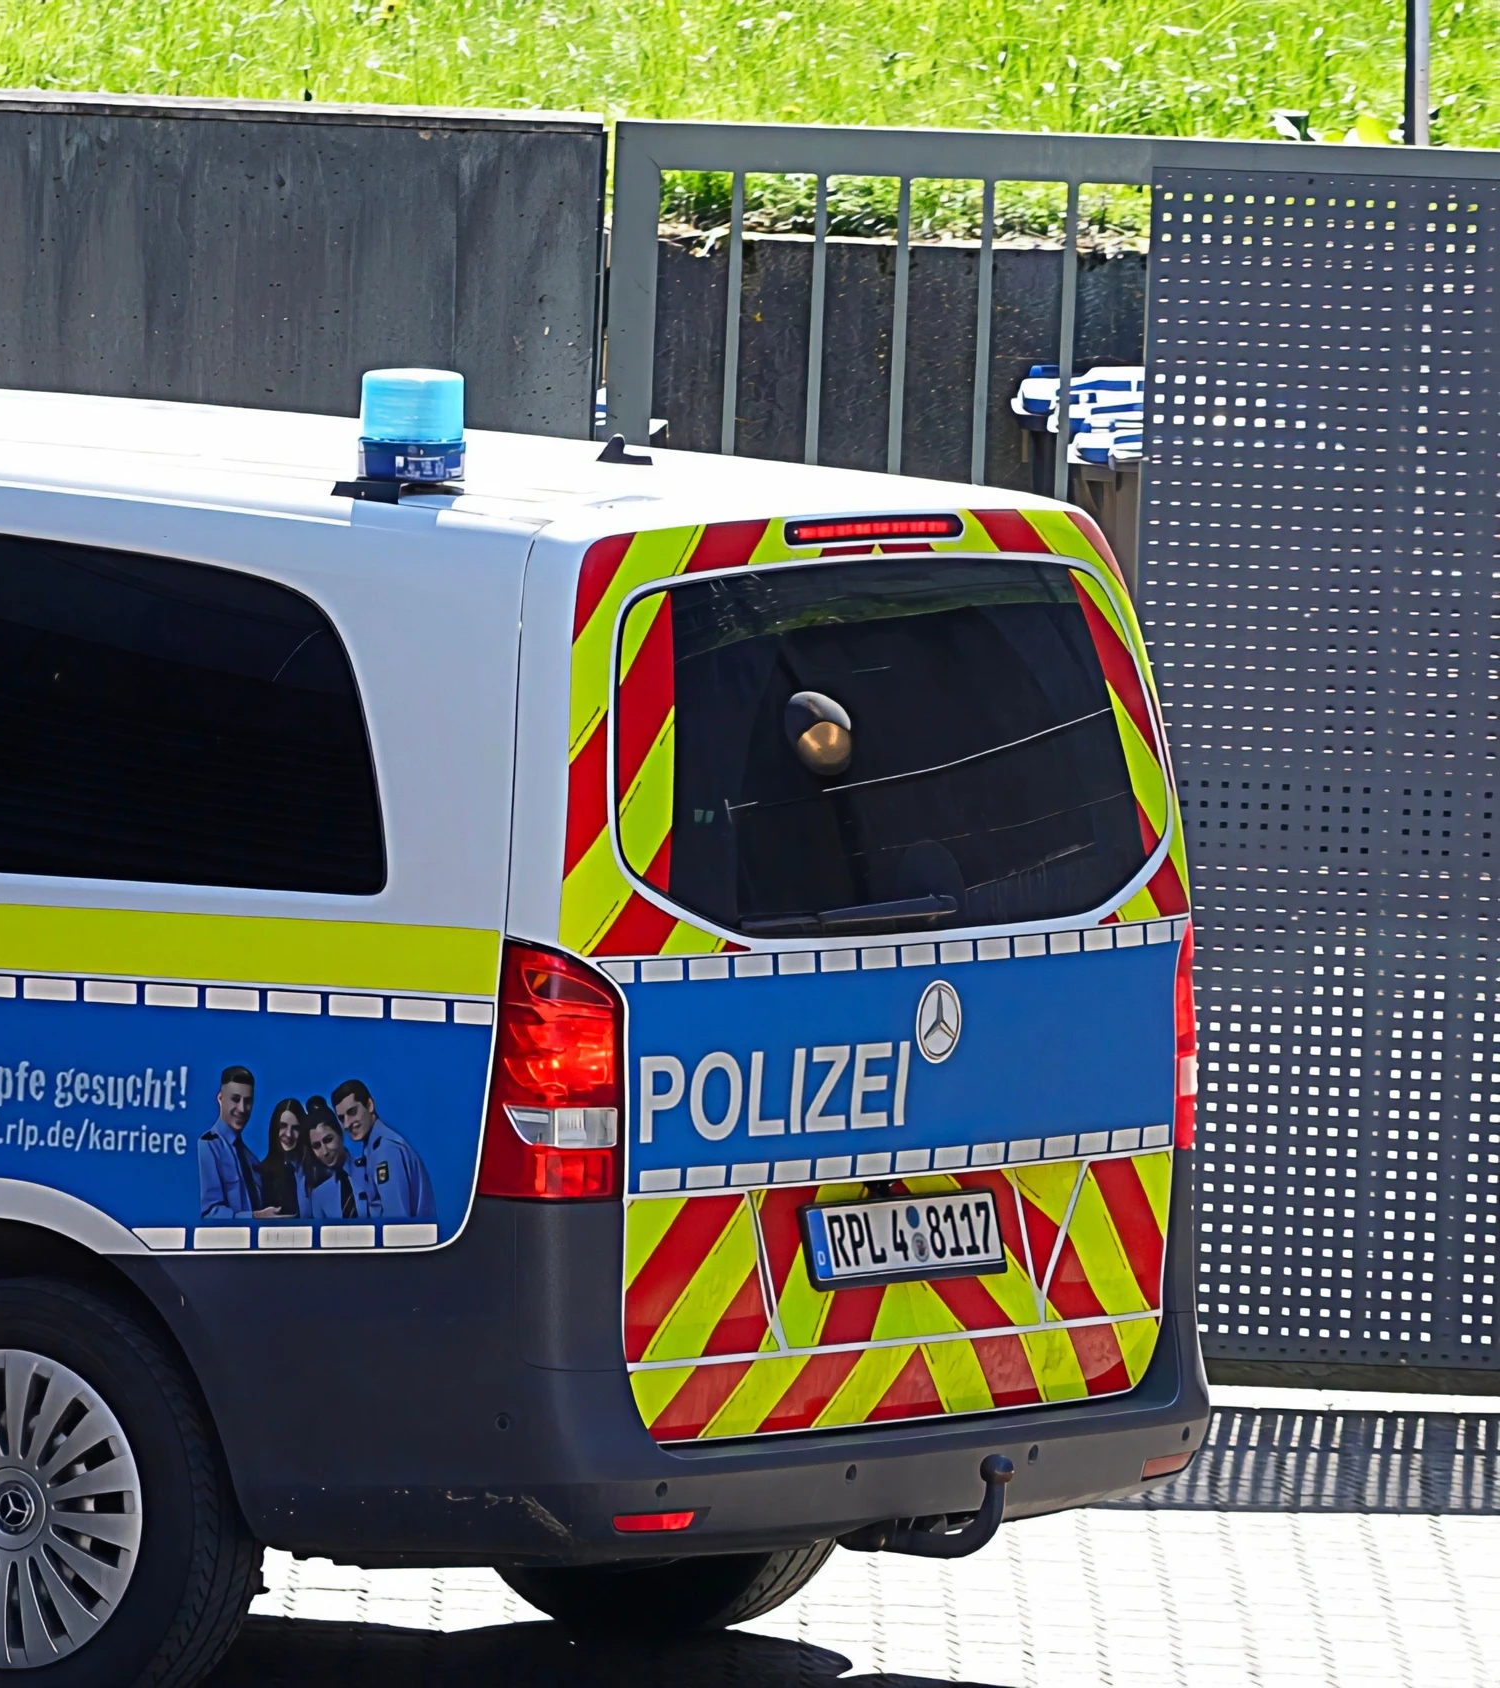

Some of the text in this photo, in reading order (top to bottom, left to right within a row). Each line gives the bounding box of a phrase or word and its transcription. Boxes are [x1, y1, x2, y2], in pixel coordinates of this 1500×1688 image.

[53, 1065, 188, 1112] gesucht!
[638, 1040, 912, 1144] POLIZEI
[827, 1211, 888, 1269] RPL
